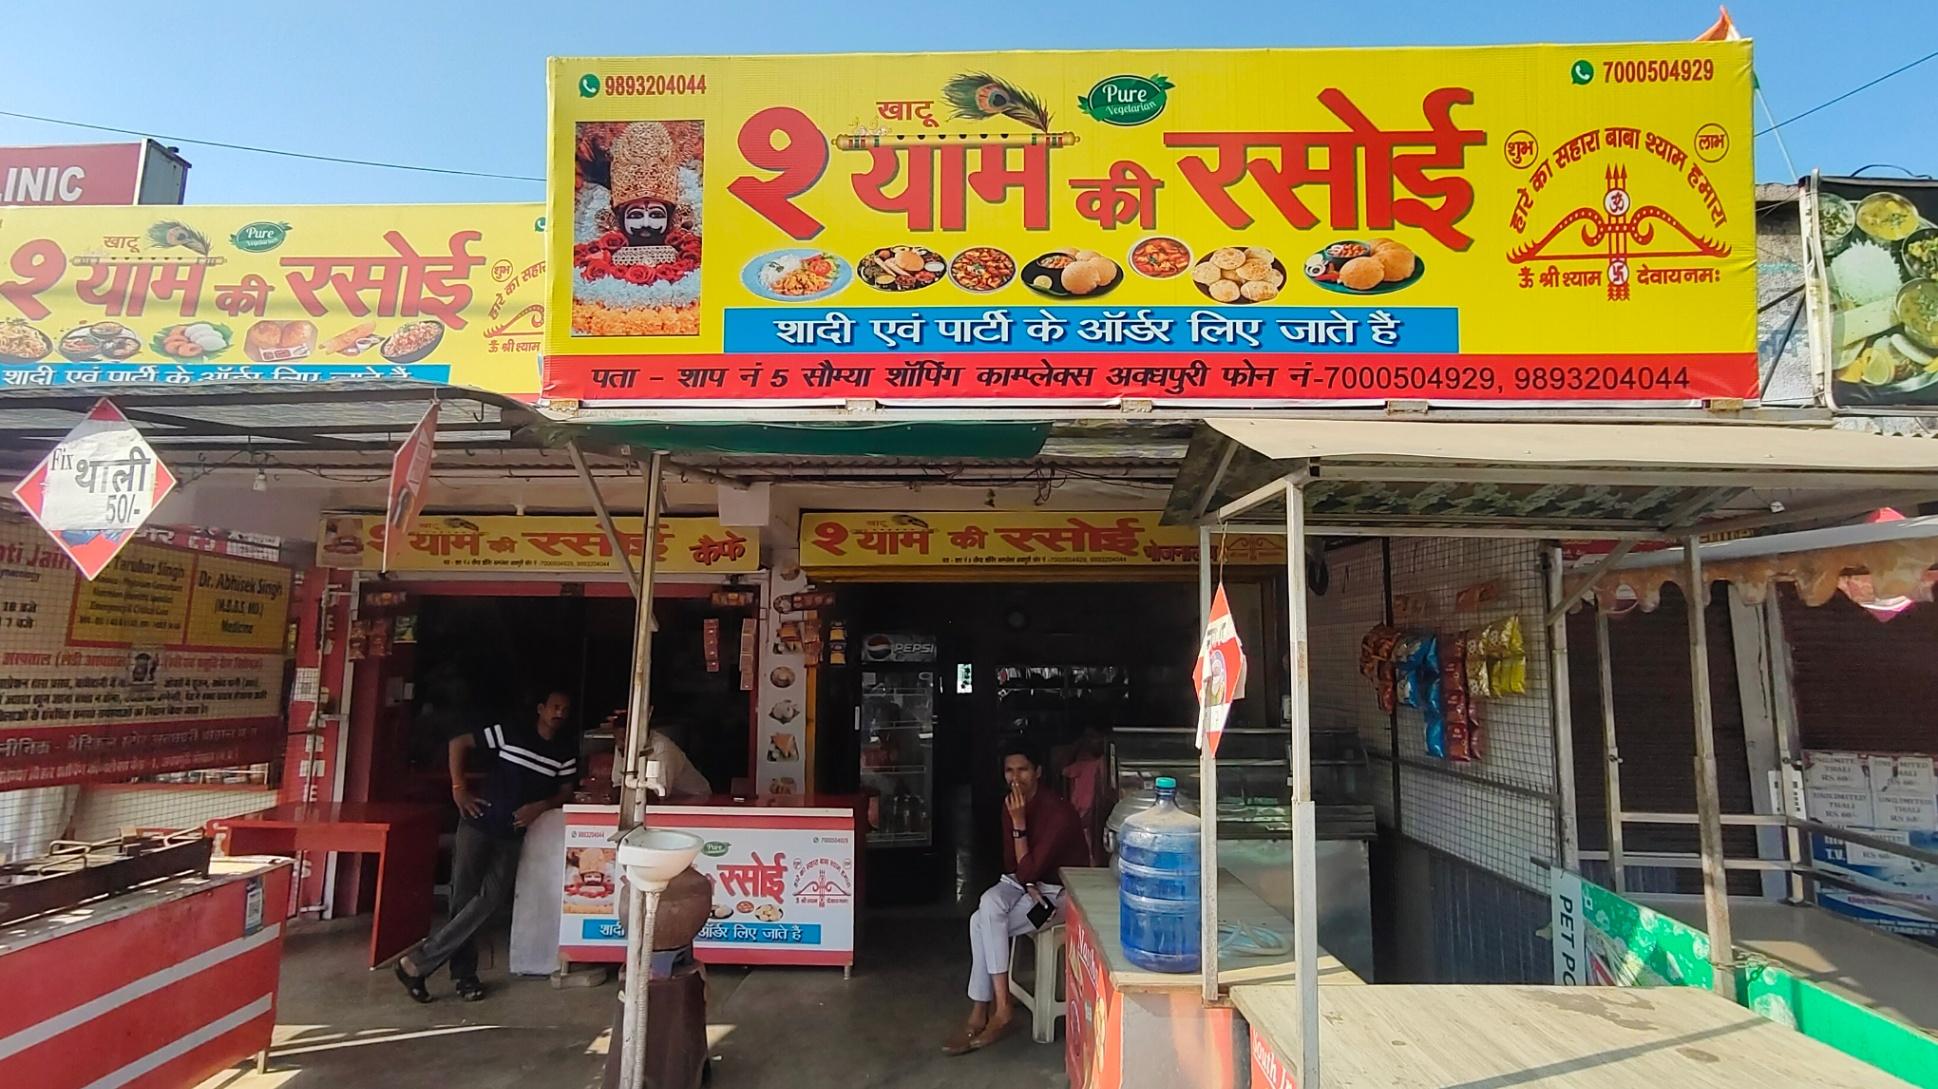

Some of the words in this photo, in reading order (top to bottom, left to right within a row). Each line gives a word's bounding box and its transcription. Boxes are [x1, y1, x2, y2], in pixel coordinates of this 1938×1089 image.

[1603, 59, 1714, 83] 7000504929
[605, 74, 706, 96] 9893204044
[1102, 83, 1147, 103] Pure
[876, 100, 939, 128] खाटू
[1105, 101, 1157, 115] Vegetarian
[1506, 140, 1534, 165] शुभ
[1698, 133, 1725, 150] लाभ
[1069, 160, 1164, 230] की
[1163, 87, 1486, 252] रसोई
[1509, 187, 1535, 235] हारे
[1529, 159, 1554, 193] का
[1553, 129, 1601, 169] सहारा
[1605, 127, 1641, 150] बाबा
[1645, 131, 1689, 172] श्याम
[1687, 162, 1727, 229] हमारा
[0, 166, 85, 202] INIC
[103, 235, 141, 254] खाटू
[246, 227, 275, 239] Pure
[214, 274, 275, 317] की
[279, 229, 487, 331] रसोई
[1539, 265, 1560, 288] श्री
[1562, 271, 1602, 288] श्याम
[773, 311, 857, 344] शादी
[869, 312, 926, 347] एवं
[934, 309, 1014, 343] पार्टी
[1023, 309, 1068, 343] के
[1077, 310, 1175, 343] ऑर्डर
[1187, 310, 1263, 347] लिए
[1275, 310, 1359, 343] जाते
[1367, 310, 1402, 345] हैं
[2, 365, 57, 385] शादी
[65, 366, 103, 384] एवं
[164, 365, 195, 385] के
[591, 368, 640, 388] पता
[677, 368, 729, 388] शाप
[739, 361, 763, 388] नं
[769, 369, 789, 388] 5
[801, 360, 875, 388] सौम्या
[885, 359, 965, 388] शॉपिंग
[976, 359, 1098, 388] काम्प्लेक्स
[1221, 359, 1280, 388] फोन
[1514, 366, 1691, 390] 9893204044
[50, 448, 74, 471] Fix
[74, 446, 151, 494] थाली
[947, 526, 988, 549] की
[993, 517, 1146, 556] रसोई
[895, 643, 934, 653] PEPSI
[716, 851, 788, 904] रसोई
[734, 924, 757, 940] लिए
[762, 924, 789, 940] जाते
[1560, 894, 1575, 950] PET
